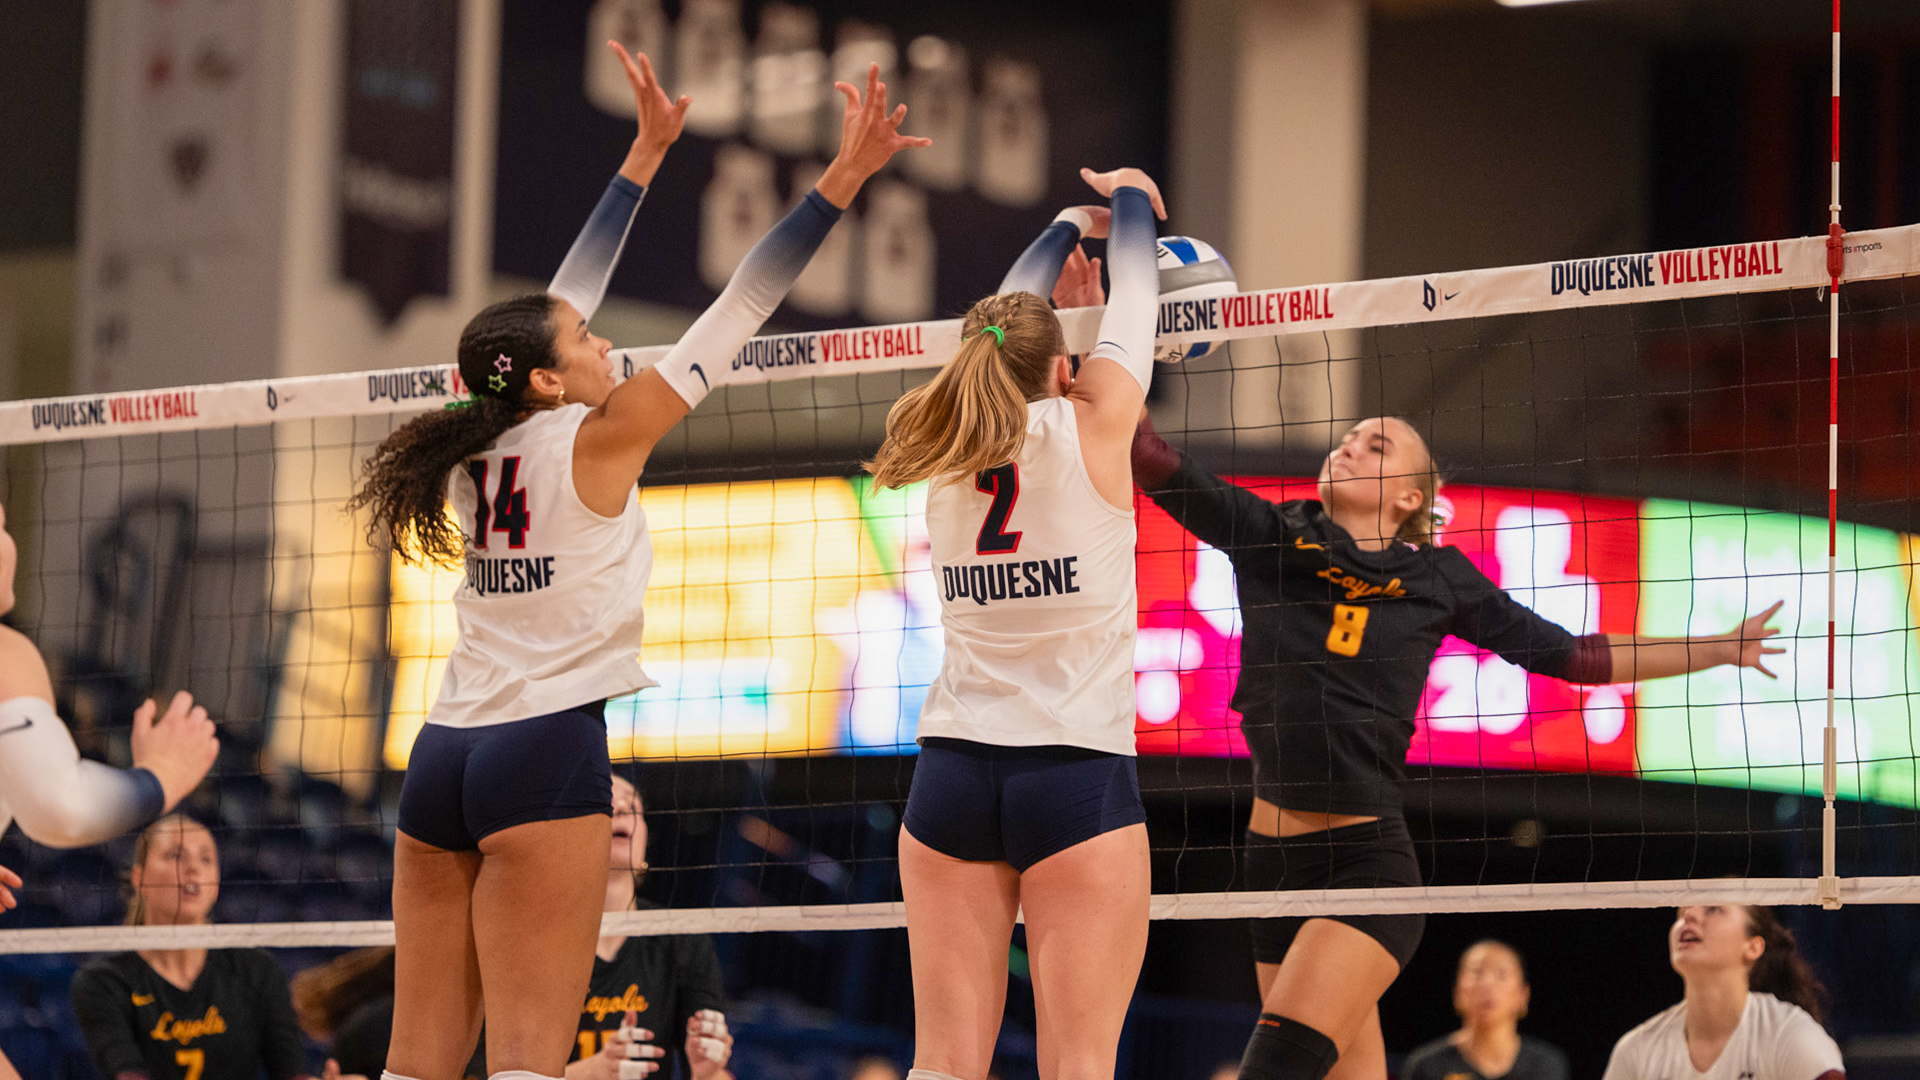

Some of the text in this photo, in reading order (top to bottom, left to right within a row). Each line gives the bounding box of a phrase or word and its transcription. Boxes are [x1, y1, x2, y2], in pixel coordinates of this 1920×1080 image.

[1551, 241, 1784, 296] DUQUESNE VOLLEYBALL
[1221, 287, 1335, 329] VOLLEYBALL
[820, 325, 924, 363] VOLLEYBALL
[368, 368, 448, 403] DUQUESNE
[31, 391, 198, 430] DUQUESNE VOLLEYBALL
[468, 456, 531, 549] 14
[975, 459, 1024, 556] 2
[942, 555, 1081, 606] DUQUESNE
[1326, 603, 1369, 657] 8
[584, 983, 649, 1022] oyola
[175, 1047, 206, 1080] 7
